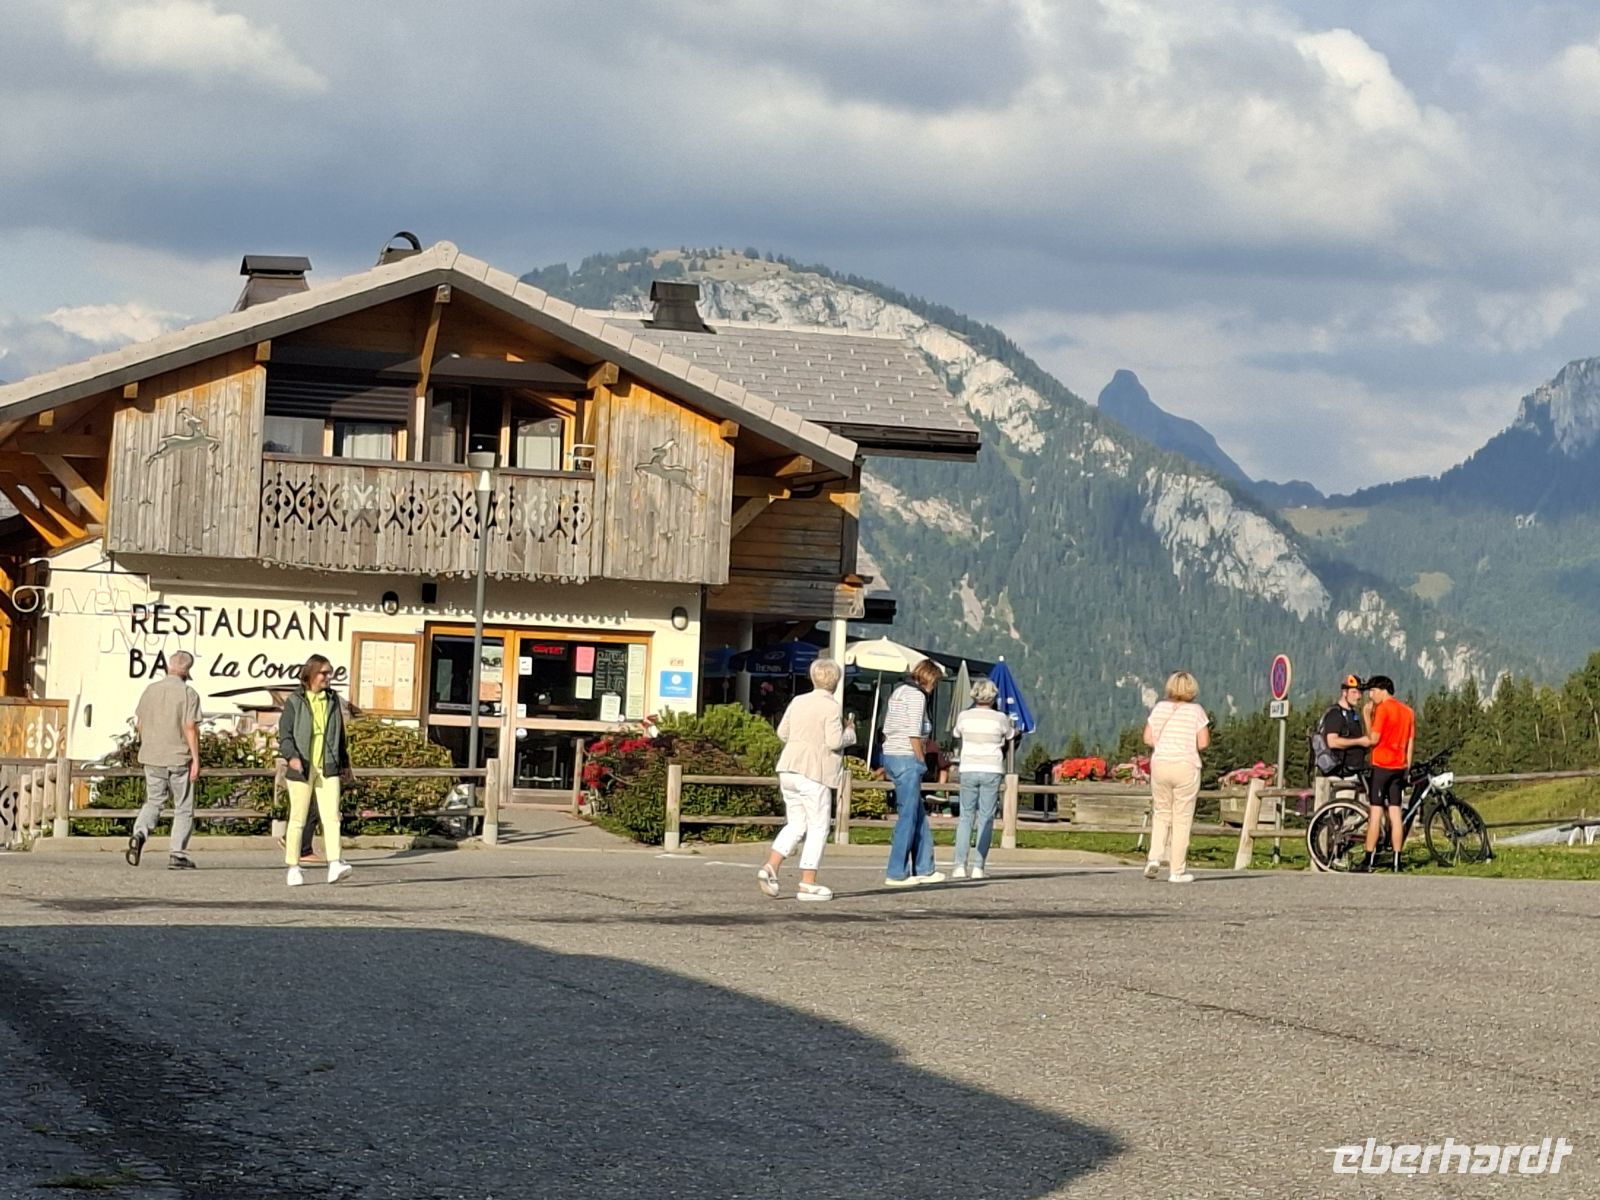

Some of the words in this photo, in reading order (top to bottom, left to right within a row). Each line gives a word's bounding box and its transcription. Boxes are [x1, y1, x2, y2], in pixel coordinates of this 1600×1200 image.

[131, 603, 350, 642] RESTAURANT
[129, 648, 193, 681] BA
[209, 652, 240, 678] La
[247, 653, 348, 681] Covae
